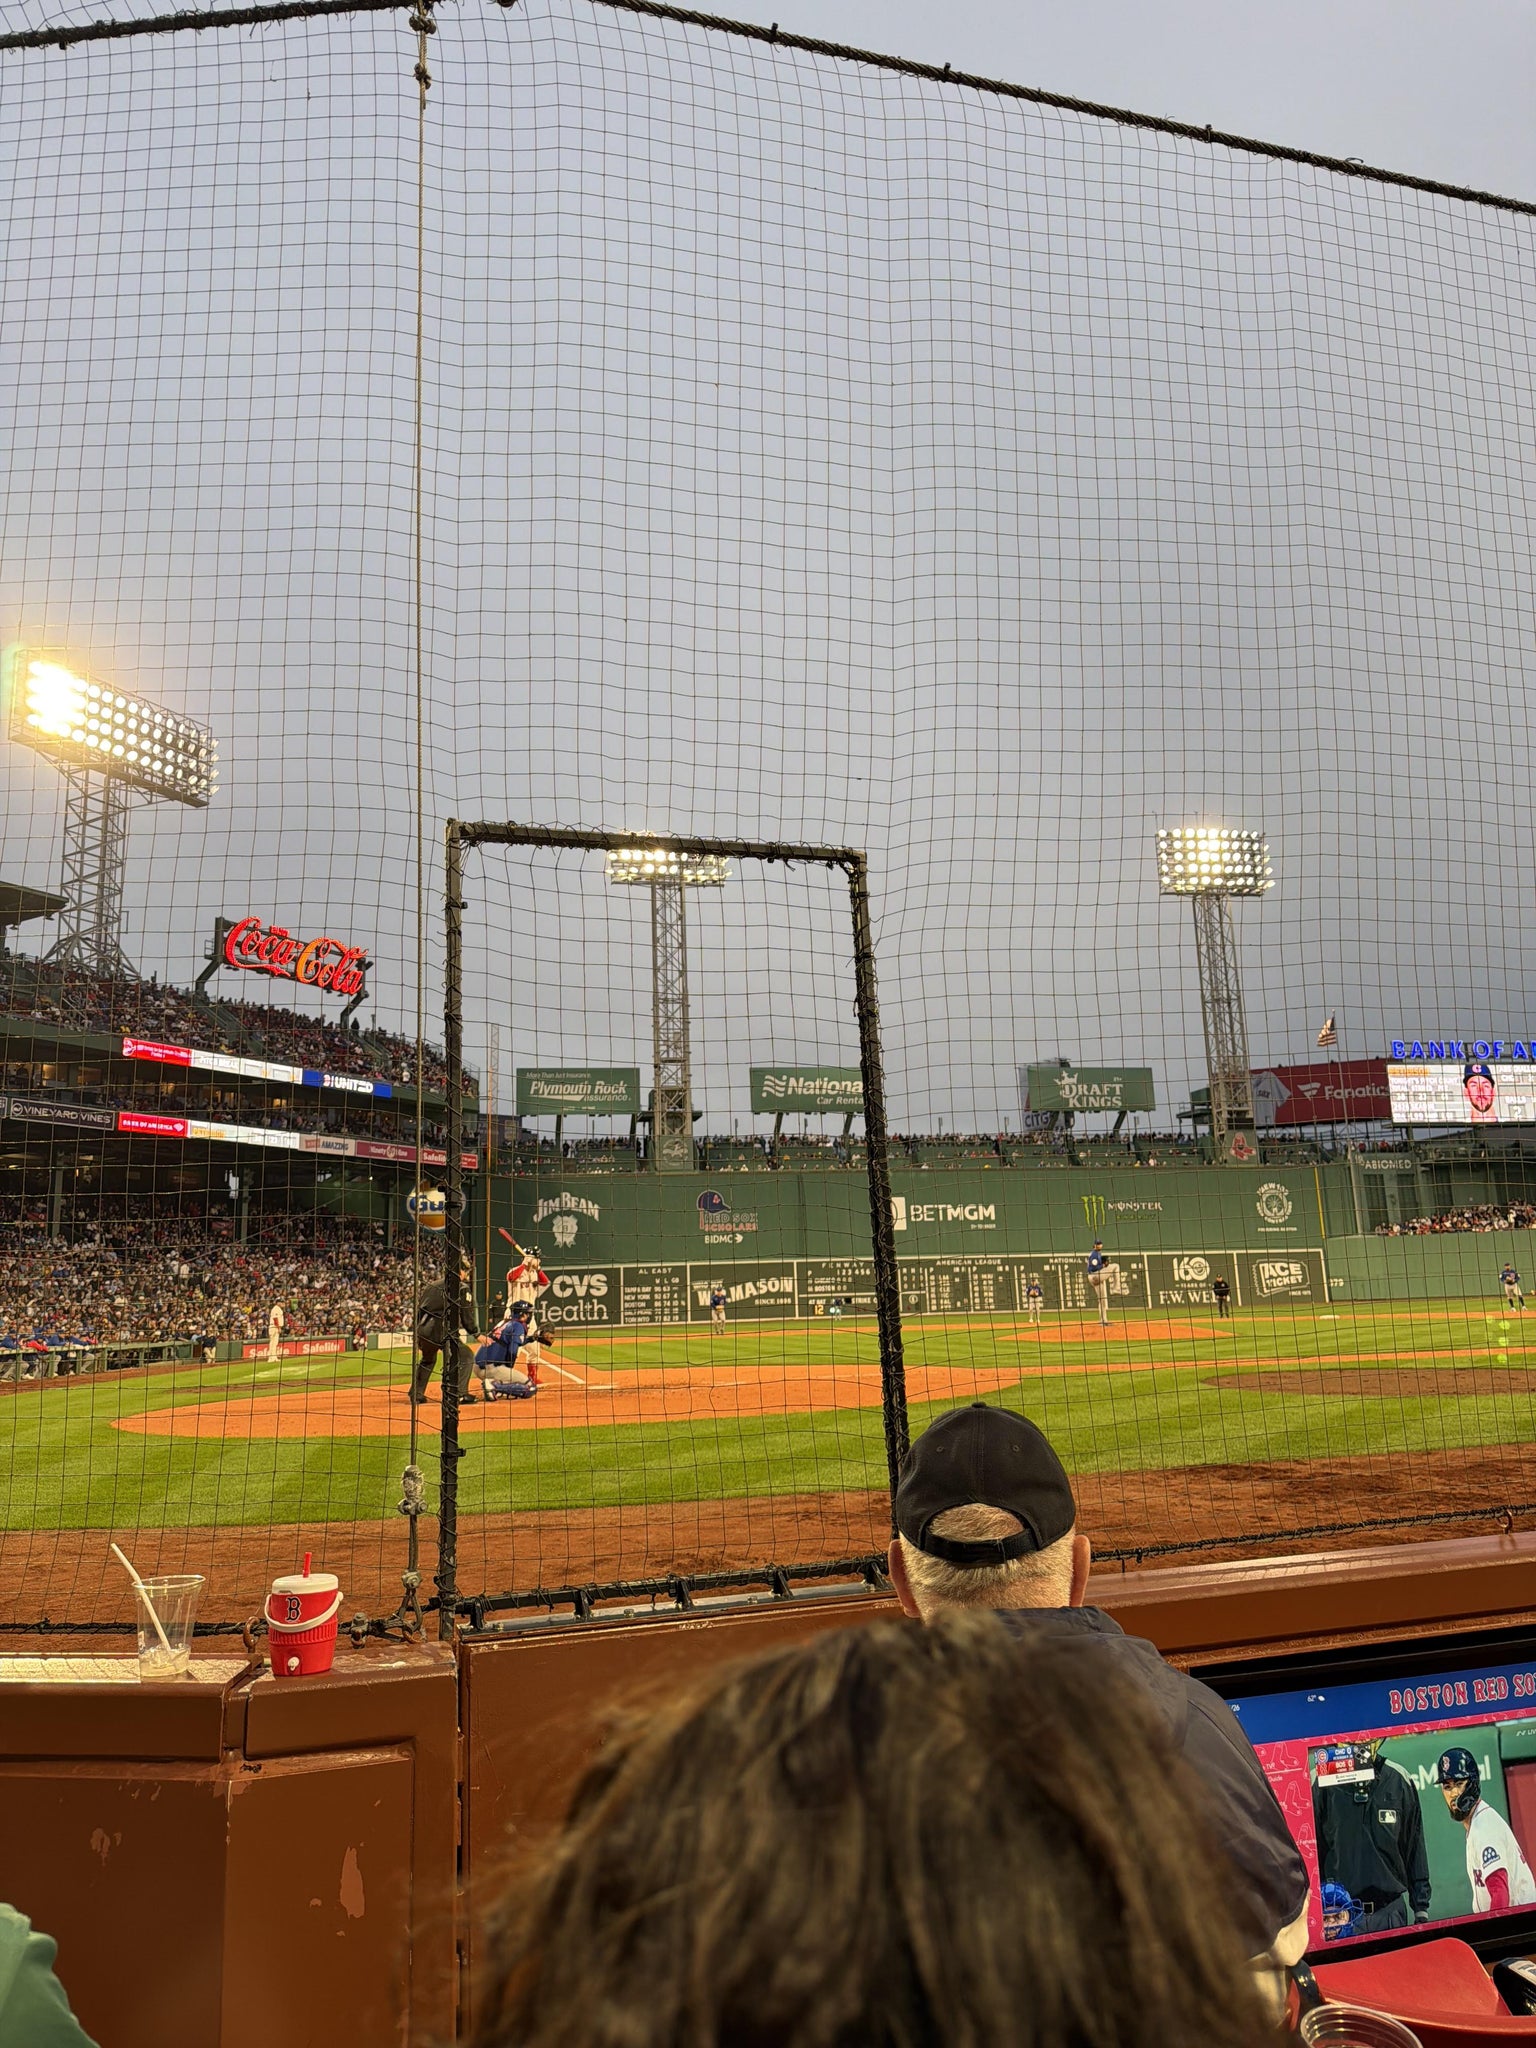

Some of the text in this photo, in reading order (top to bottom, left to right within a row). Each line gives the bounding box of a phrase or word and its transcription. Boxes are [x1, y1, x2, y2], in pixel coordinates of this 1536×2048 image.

[225, 916, 369, 995] Coca-Cola
[1391, 1040, 1466, 1059] BANK
[1473, 1040, 1505, 1059] OF
[334, 1076, 373, 1093] UNITED
[530, 1080, 627, 1097] Plymouth Rock
[787, 1077, 864, 1095] Nationa
[1060, 1083, 1123, 1098] DRAFT
[817, 1096, 864, 1105] Car Renta
[1069, 1096, 1122, 1108] KINGS
[23, 1105, 112, 1124] VINEYARD VINES
[1024, 1112, 1052, 1128] CITG
[423, 1151, 446, 1164] Safelit
[1365, 1160, 1412, 1169] ABIOMED
[410, 1195, 445, 1212] Gu
[533, 1191, 600, 1223] JIM BEAM
[1107, 1201, 1163, 1212] MONSTER
[704, 1212, 758, 1223] RED SOX
[910, 1203, 996, 1221] BETMGM
[704, 1234, 733, 1244] BIDMC
[1173, 1257, 1210, 1281] 160
[1264, 1263, 1303, 1278] ACE
[552, 1273, 608, 1298] CVS
[729, 1276, 794, 1303] MASON
[1265, 1275, 1303, 1288] TICKET
[1159, 1291, 1185, 1304] F.W.
[814, 1304, 824, 1315] 12
[302, 1342, 340, 1354] Safelite
[285, 1596, 302, 1623] B
[1389, 1672, 1536, 1715] BOSTON RED SO
